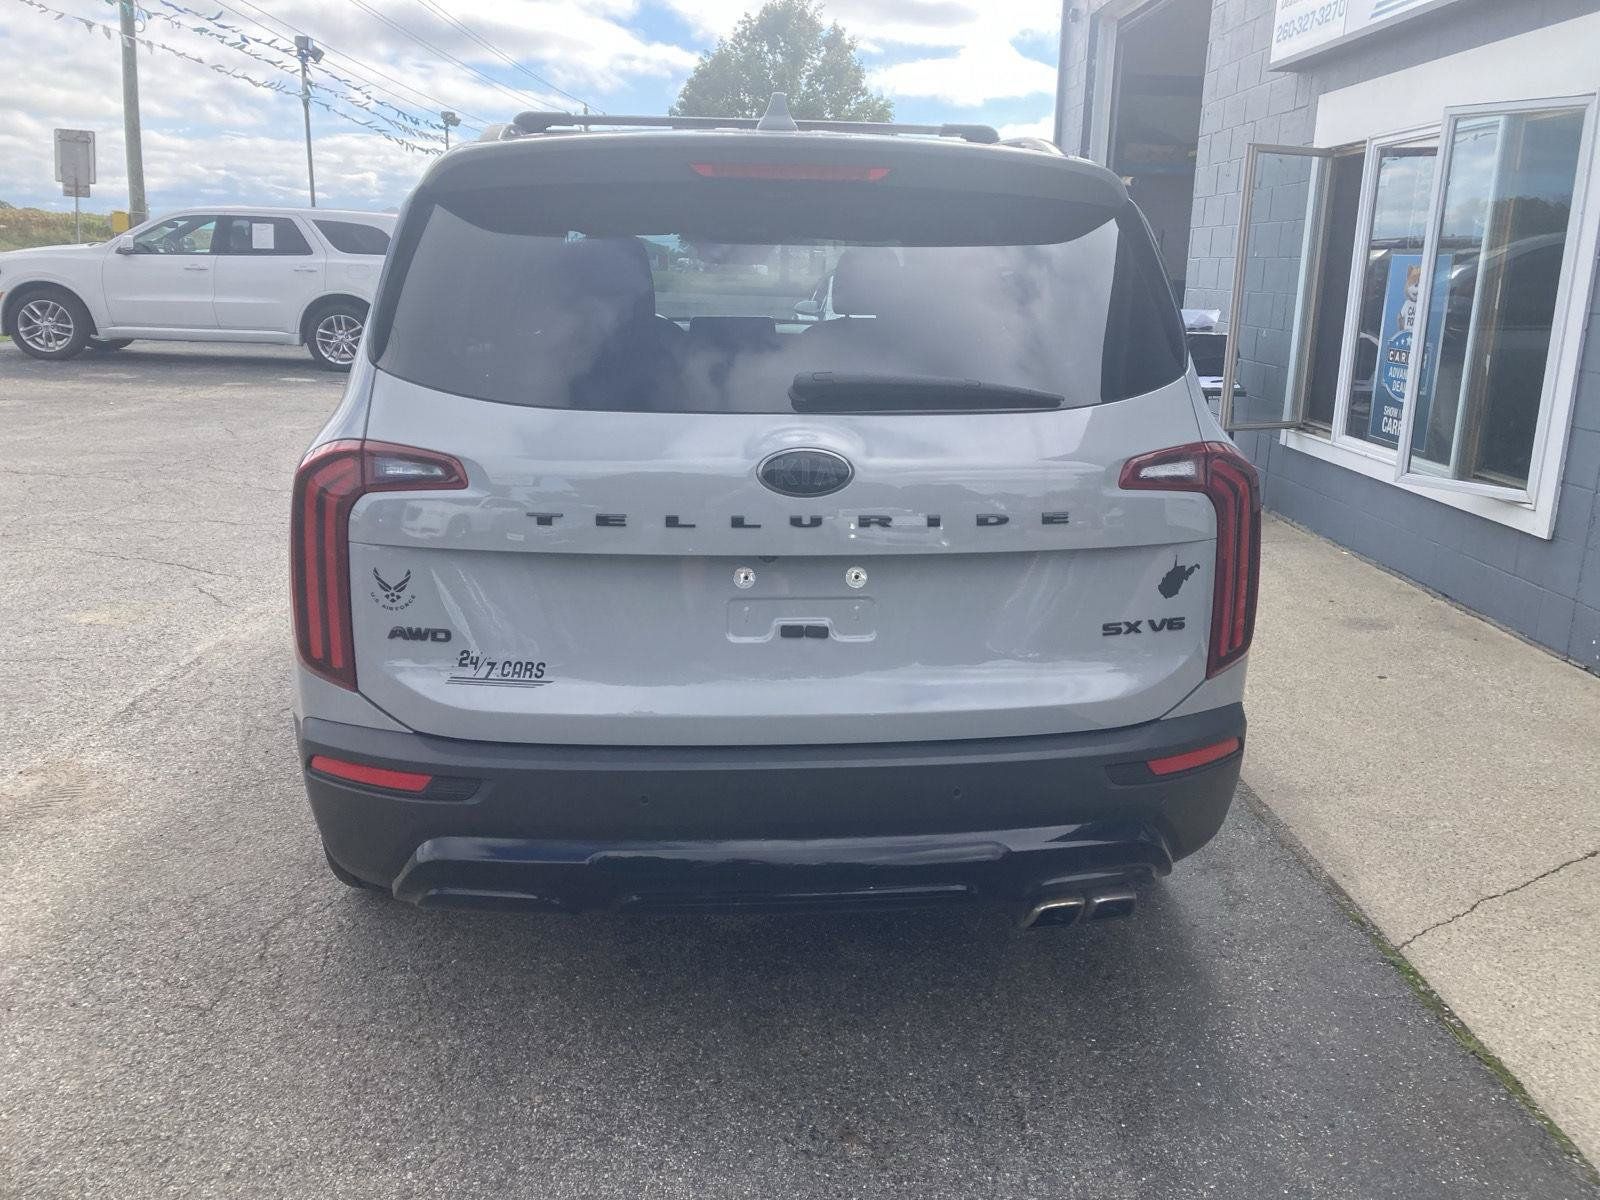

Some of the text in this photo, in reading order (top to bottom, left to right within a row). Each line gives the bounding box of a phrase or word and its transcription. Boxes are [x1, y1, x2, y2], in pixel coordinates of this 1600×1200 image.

[1276, 1, 1344, 43] 260-327-3270
[526, 510, 1070, 530] TELLURIDE
[387, 625, 452, 643] AWD
[1102, 617, 1185, 636] SX V6
[458, 650, 546, 679] 24/7 CARS
